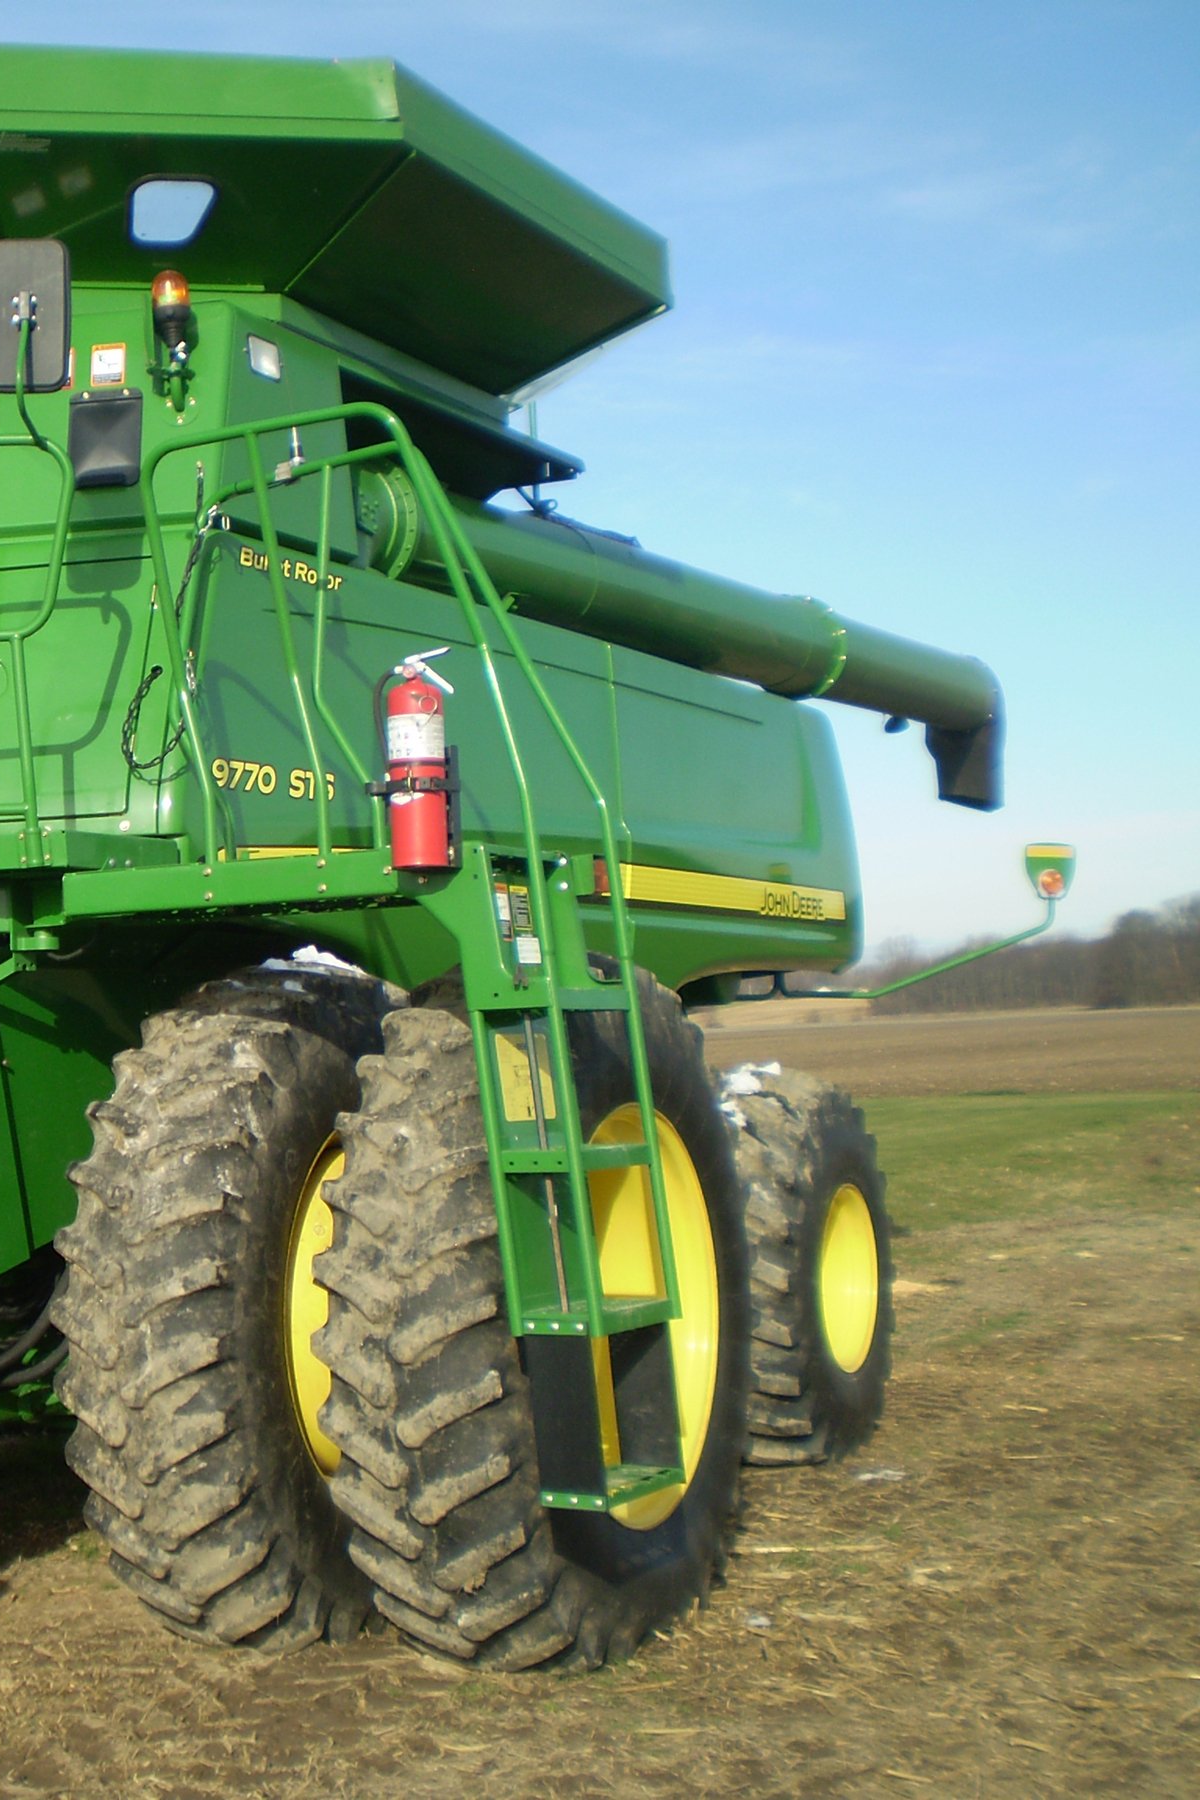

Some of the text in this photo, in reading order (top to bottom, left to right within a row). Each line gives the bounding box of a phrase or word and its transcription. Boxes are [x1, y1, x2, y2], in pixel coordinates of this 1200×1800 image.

[240, 546, 342, 590] Bult Roor
[212, 758, 276, 795] 9770
[761, 887, 790, 915] JOHN
